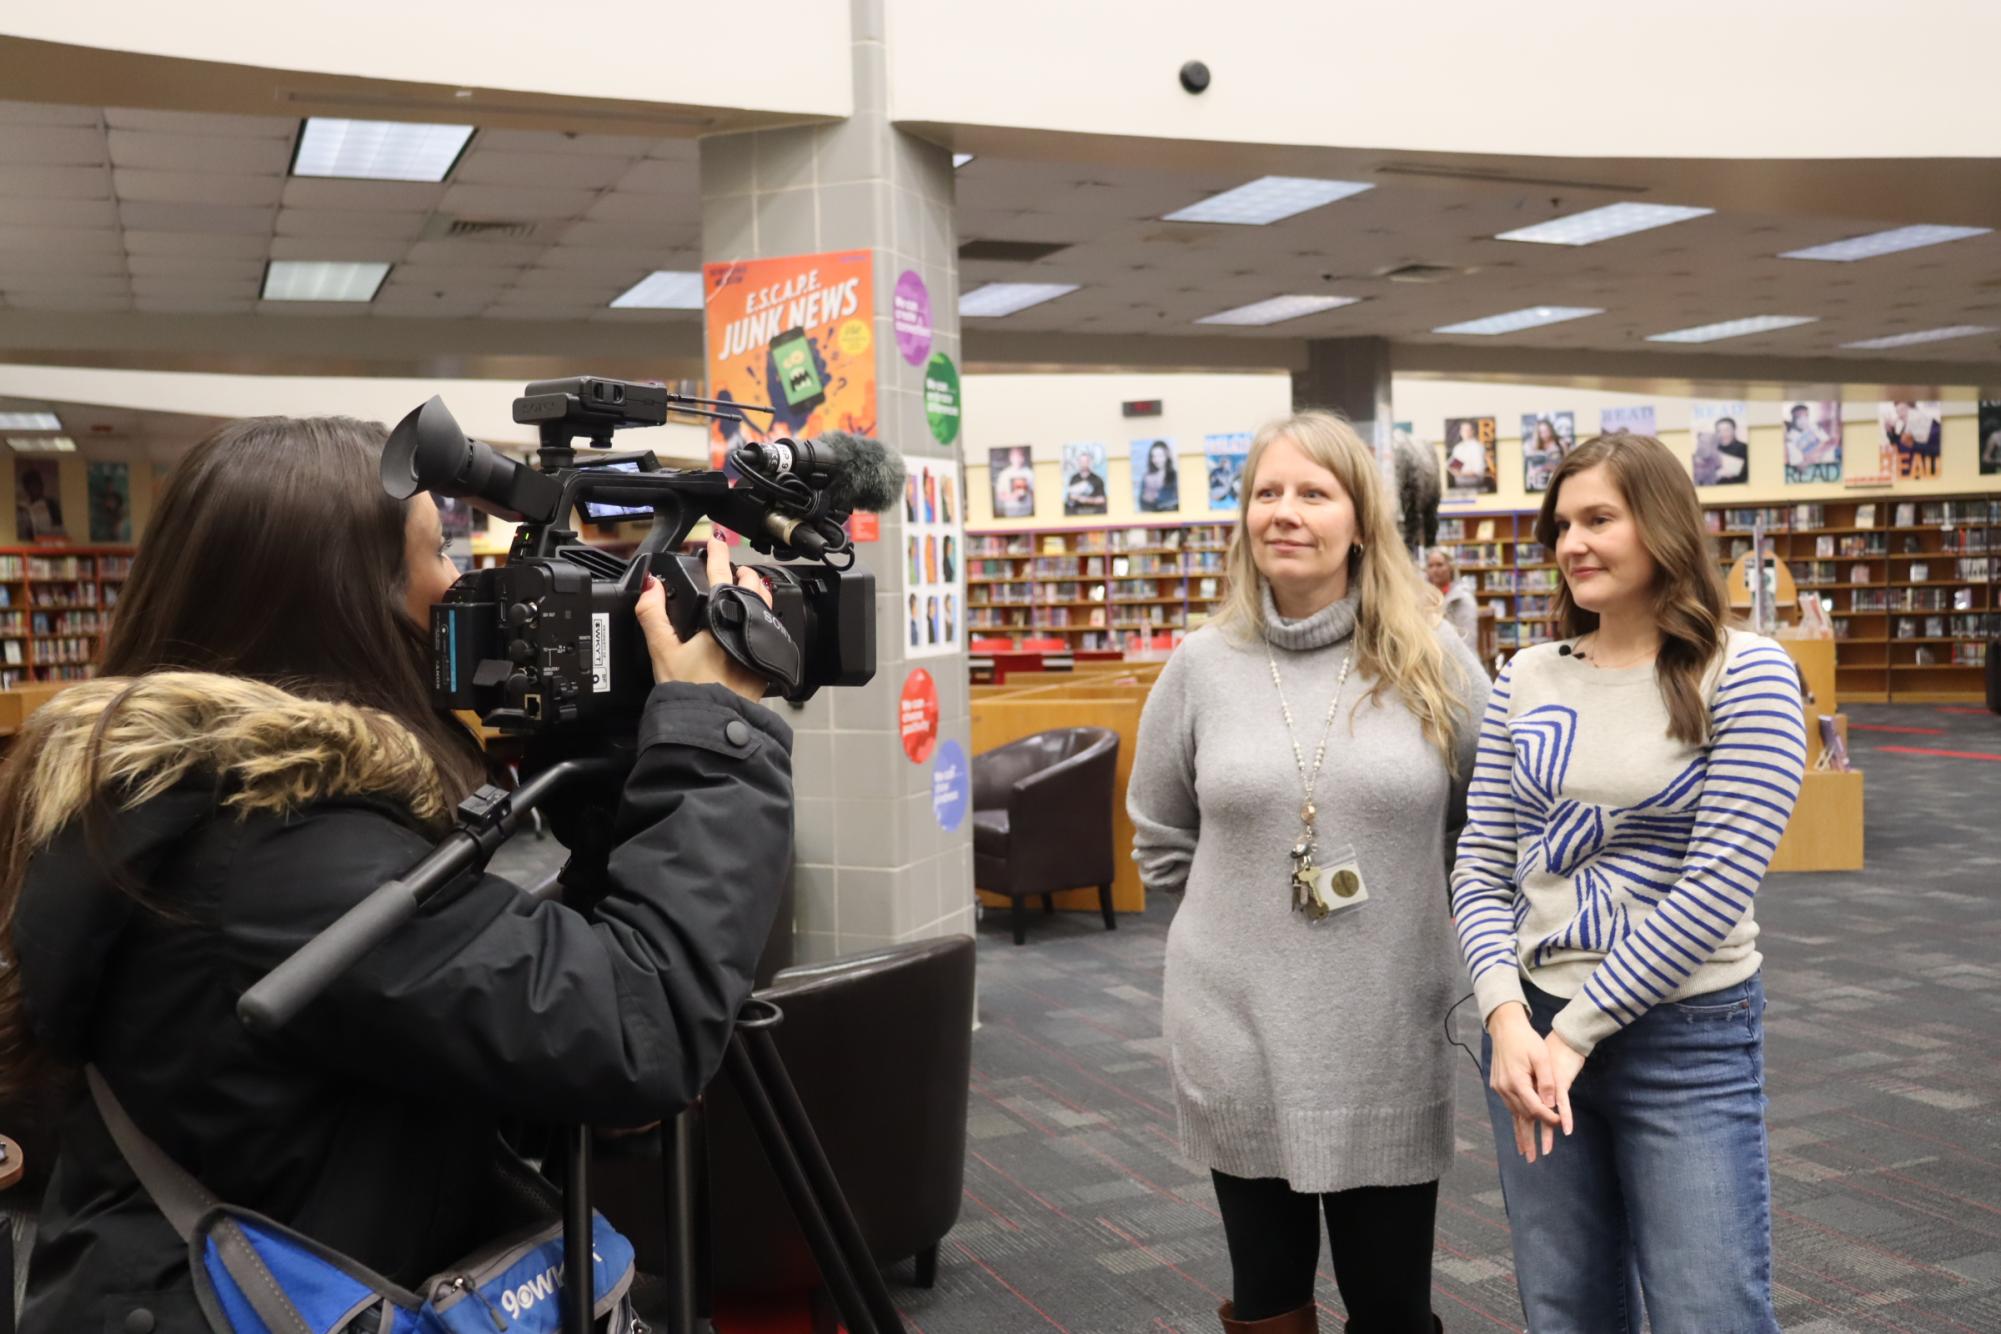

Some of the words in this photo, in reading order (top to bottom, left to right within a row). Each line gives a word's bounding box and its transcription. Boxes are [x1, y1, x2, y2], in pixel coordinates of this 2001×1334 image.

[718, 304, 785, 361] JUNK
[788, 277, 860, 331] NEWS
[1601, 406, 1654, 423] READ
[1785, 463, 1841, 485] READ
